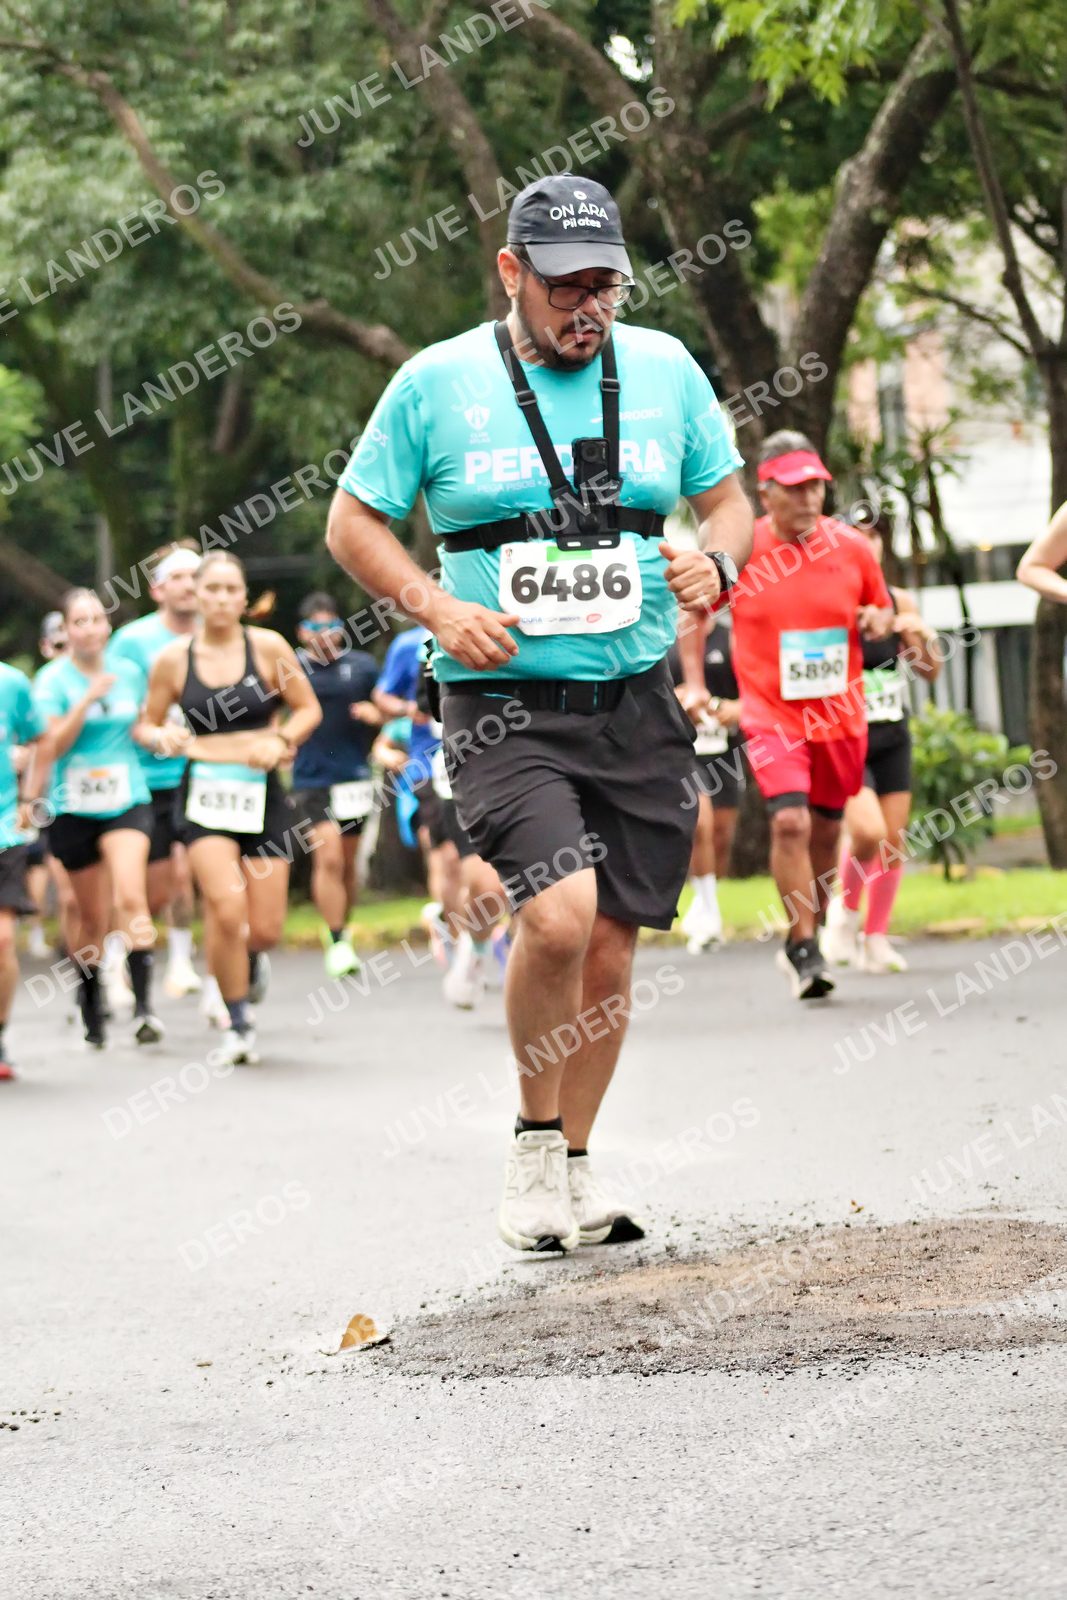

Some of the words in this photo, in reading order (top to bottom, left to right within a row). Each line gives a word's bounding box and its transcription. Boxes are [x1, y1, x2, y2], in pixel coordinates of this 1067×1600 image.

[550, 204, 575, 221] ON
[578, 202, 609, 221] ARA
[563, 217, 602, 230] Pilates
[464, 438, 666, 485] PERDRA
[511, 563, 631, 604] 6486
